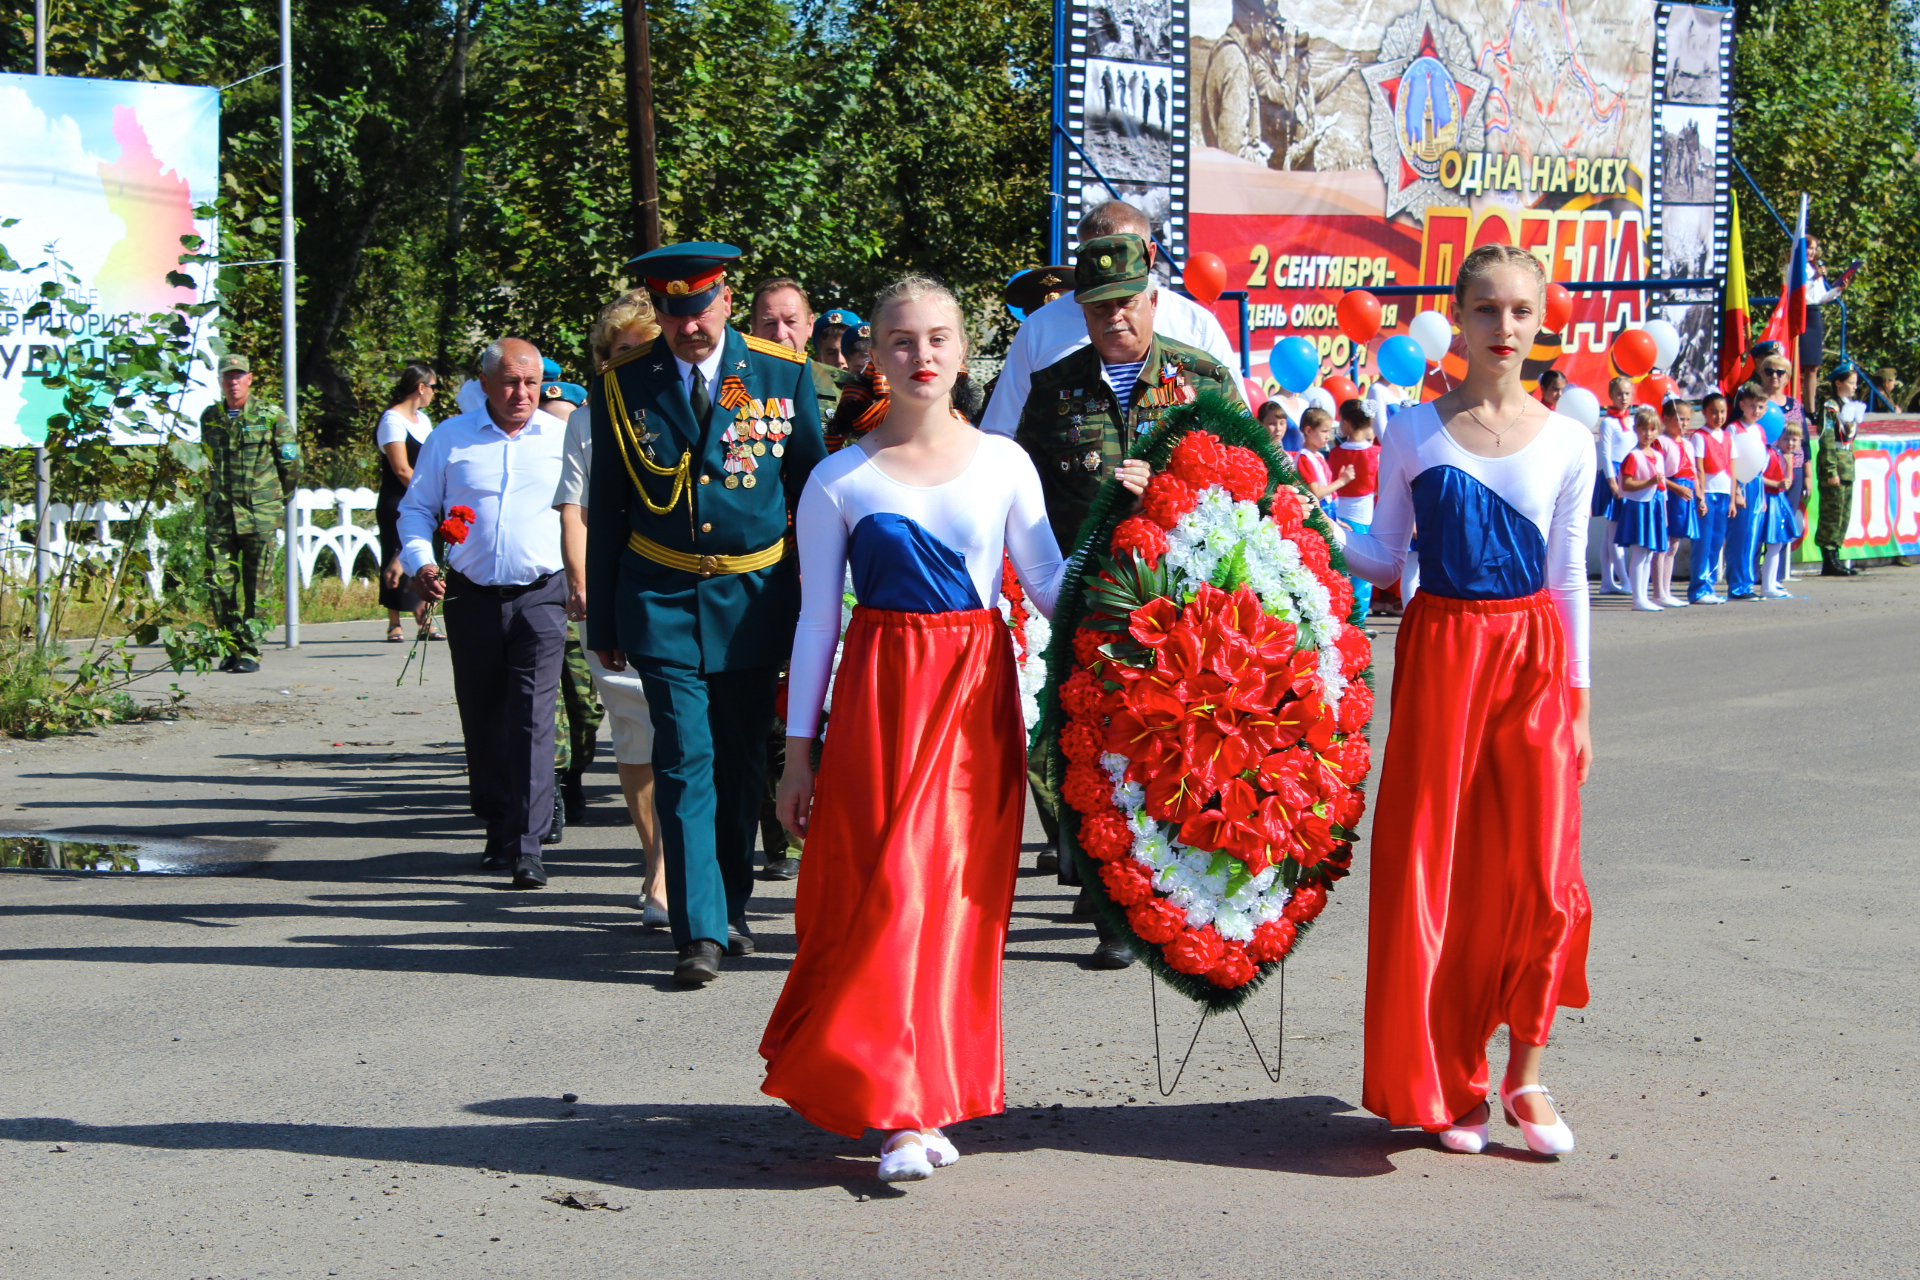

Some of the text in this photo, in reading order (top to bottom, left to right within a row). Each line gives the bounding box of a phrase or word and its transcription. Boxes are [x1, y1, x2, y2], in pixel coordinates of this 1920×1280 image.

[1440, 150, 1629, 196] ОДНА НА ВСЕХ
[1246, 244, 1269, 286] 2
[0, 313, 130, 336] РРИТОРИЯ
[1247, 304, 1288, 330] ДЕНЬ
